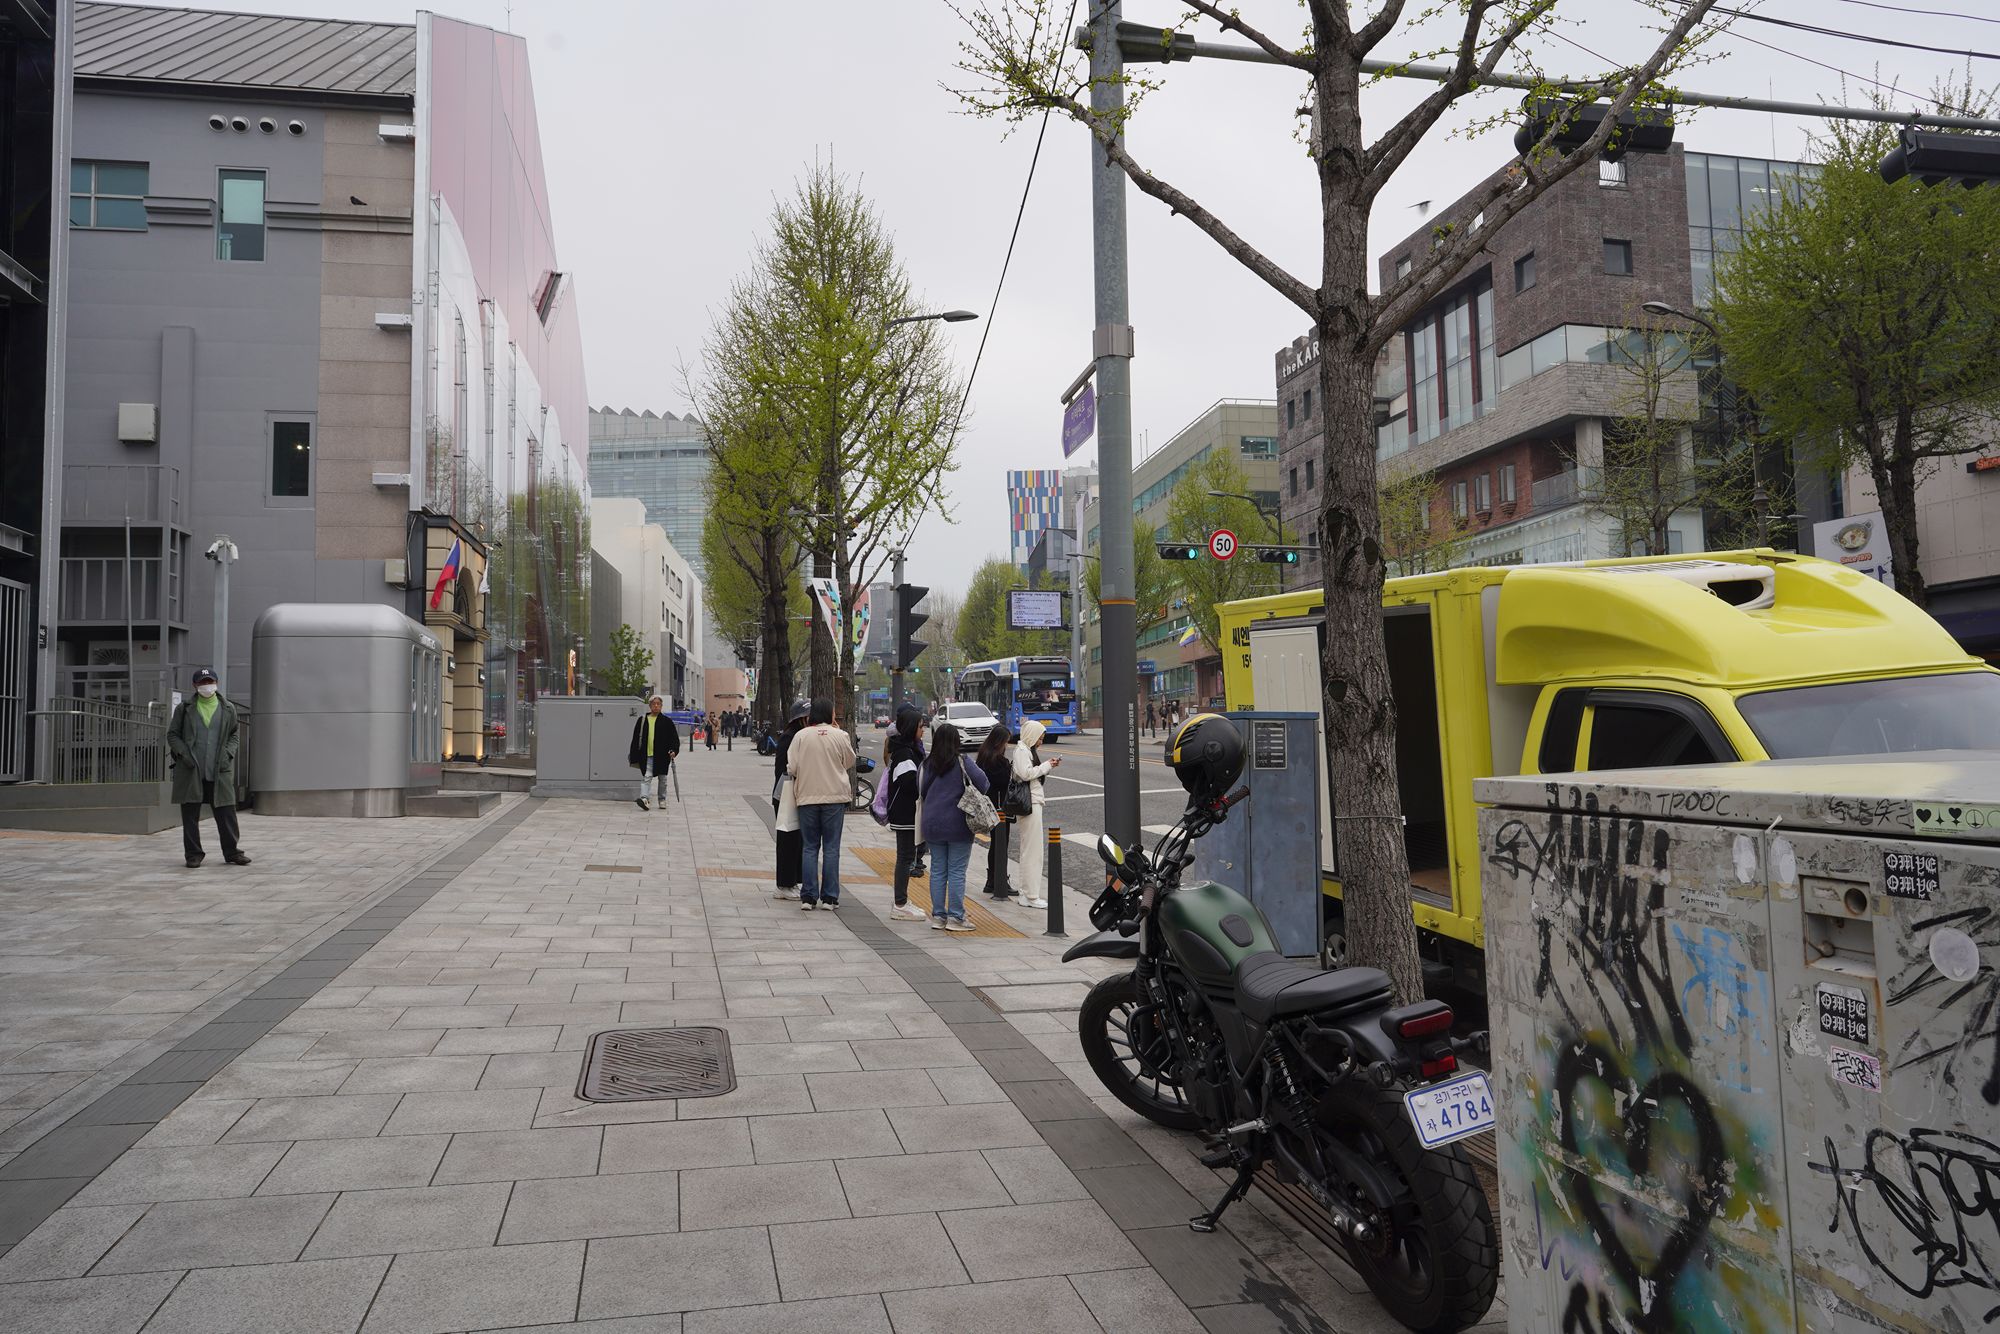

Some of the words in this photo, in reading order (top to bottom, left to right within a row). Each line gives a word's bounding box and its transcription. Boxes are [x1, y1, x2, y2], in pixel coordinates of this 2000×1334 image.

[1216, 538, 1231, 552] 50
[1051, 680, 1065, 688] 110A
[1433, 1090, 1451, 1104] 경기
[1450, 1084, 1472, 1098] 구리
[1441, 1096, 1492, 1128] 4784
